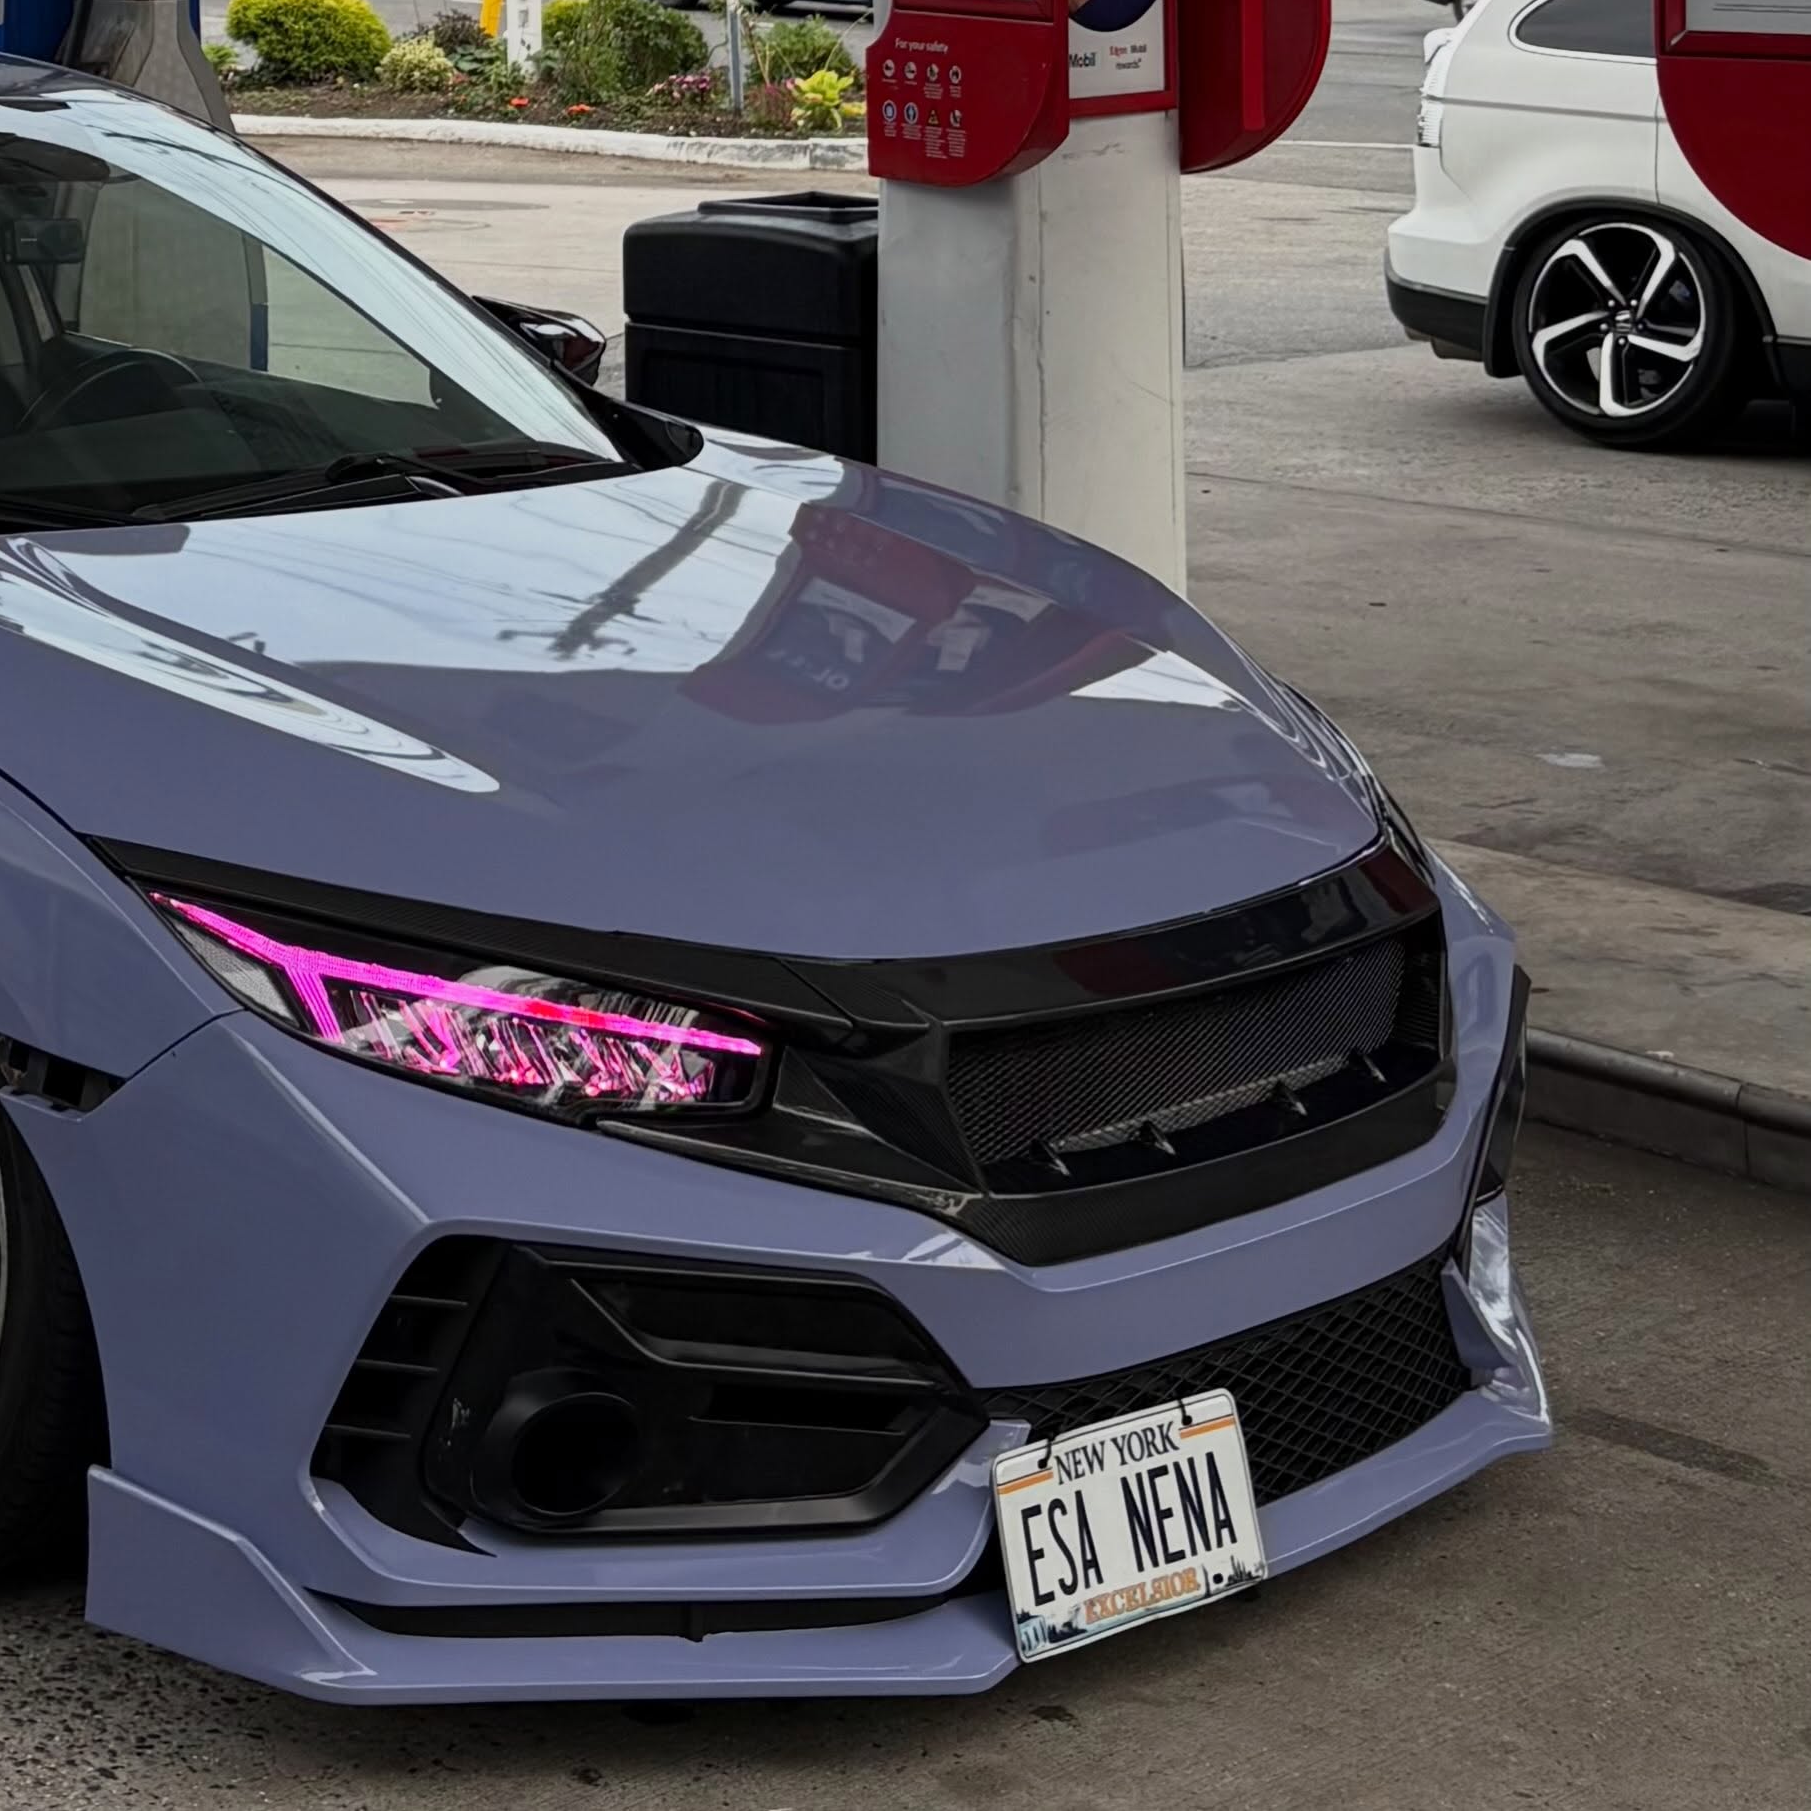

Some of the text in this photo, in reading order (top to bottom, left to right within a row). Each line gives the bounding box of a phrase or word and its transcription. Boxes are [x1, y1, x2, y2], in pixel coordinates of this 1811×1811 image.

[895, 37, 949, 54] For your safety
[1069, 53, 1095, 68] Mobil
[1054, 1421, 1180, 1485] NEW YORK
[1021, 1452, 1237, 1606] ESA NENA
[1083, 1567, 1201, 1624] EXCELSIOR
